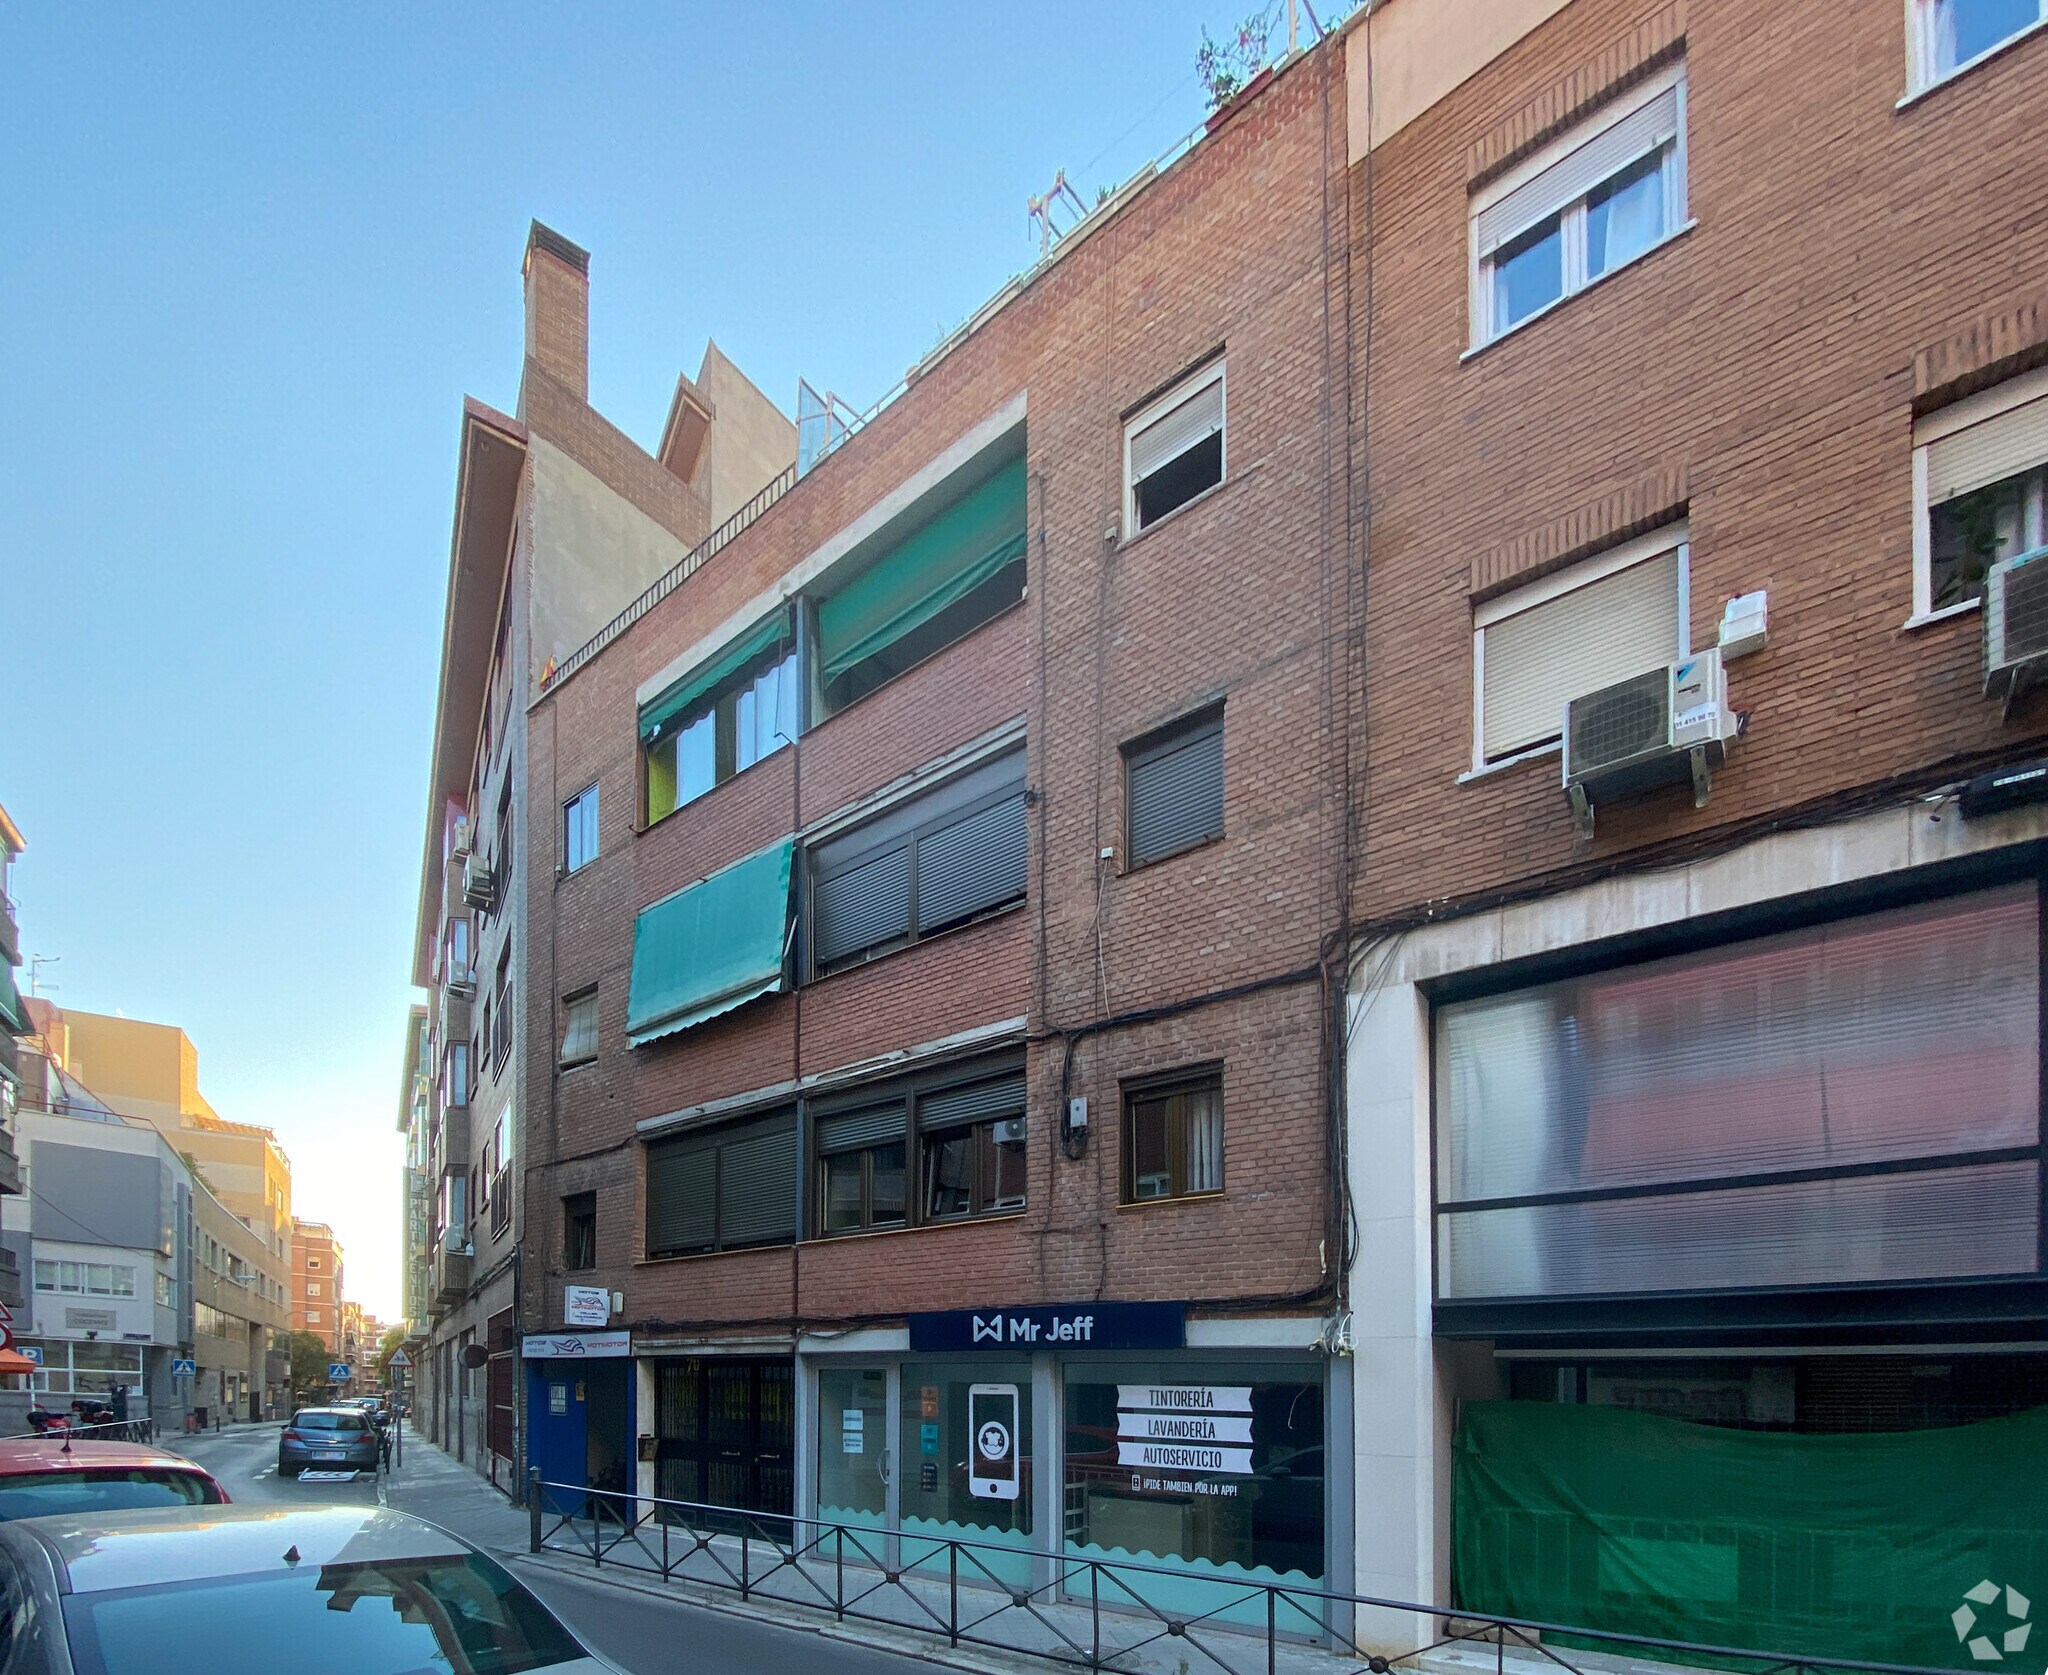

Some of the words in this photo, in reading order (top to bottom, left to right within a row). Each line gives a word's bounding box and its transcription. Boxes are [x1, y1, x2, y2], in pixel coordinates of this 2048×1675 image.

[1009, 1318, 1041, 1341] Mr
[1045, 1316, 1094, 1341] Jeff
[1149, 1387, 1214, 1408] TINTORERÍA
[1148, 1418, 1216, 1439] LAVANDERÍA
[1143, 1447, 1222, 1468] AUTOSERVICIO
[1163, 1480, 1193, 1493] TAMBIEN
[1194, 1482, 1208, 1495] POR
[1210, 1484, 1219, 1495] LA
[1221, 1485, 1238, 1497] APP!
